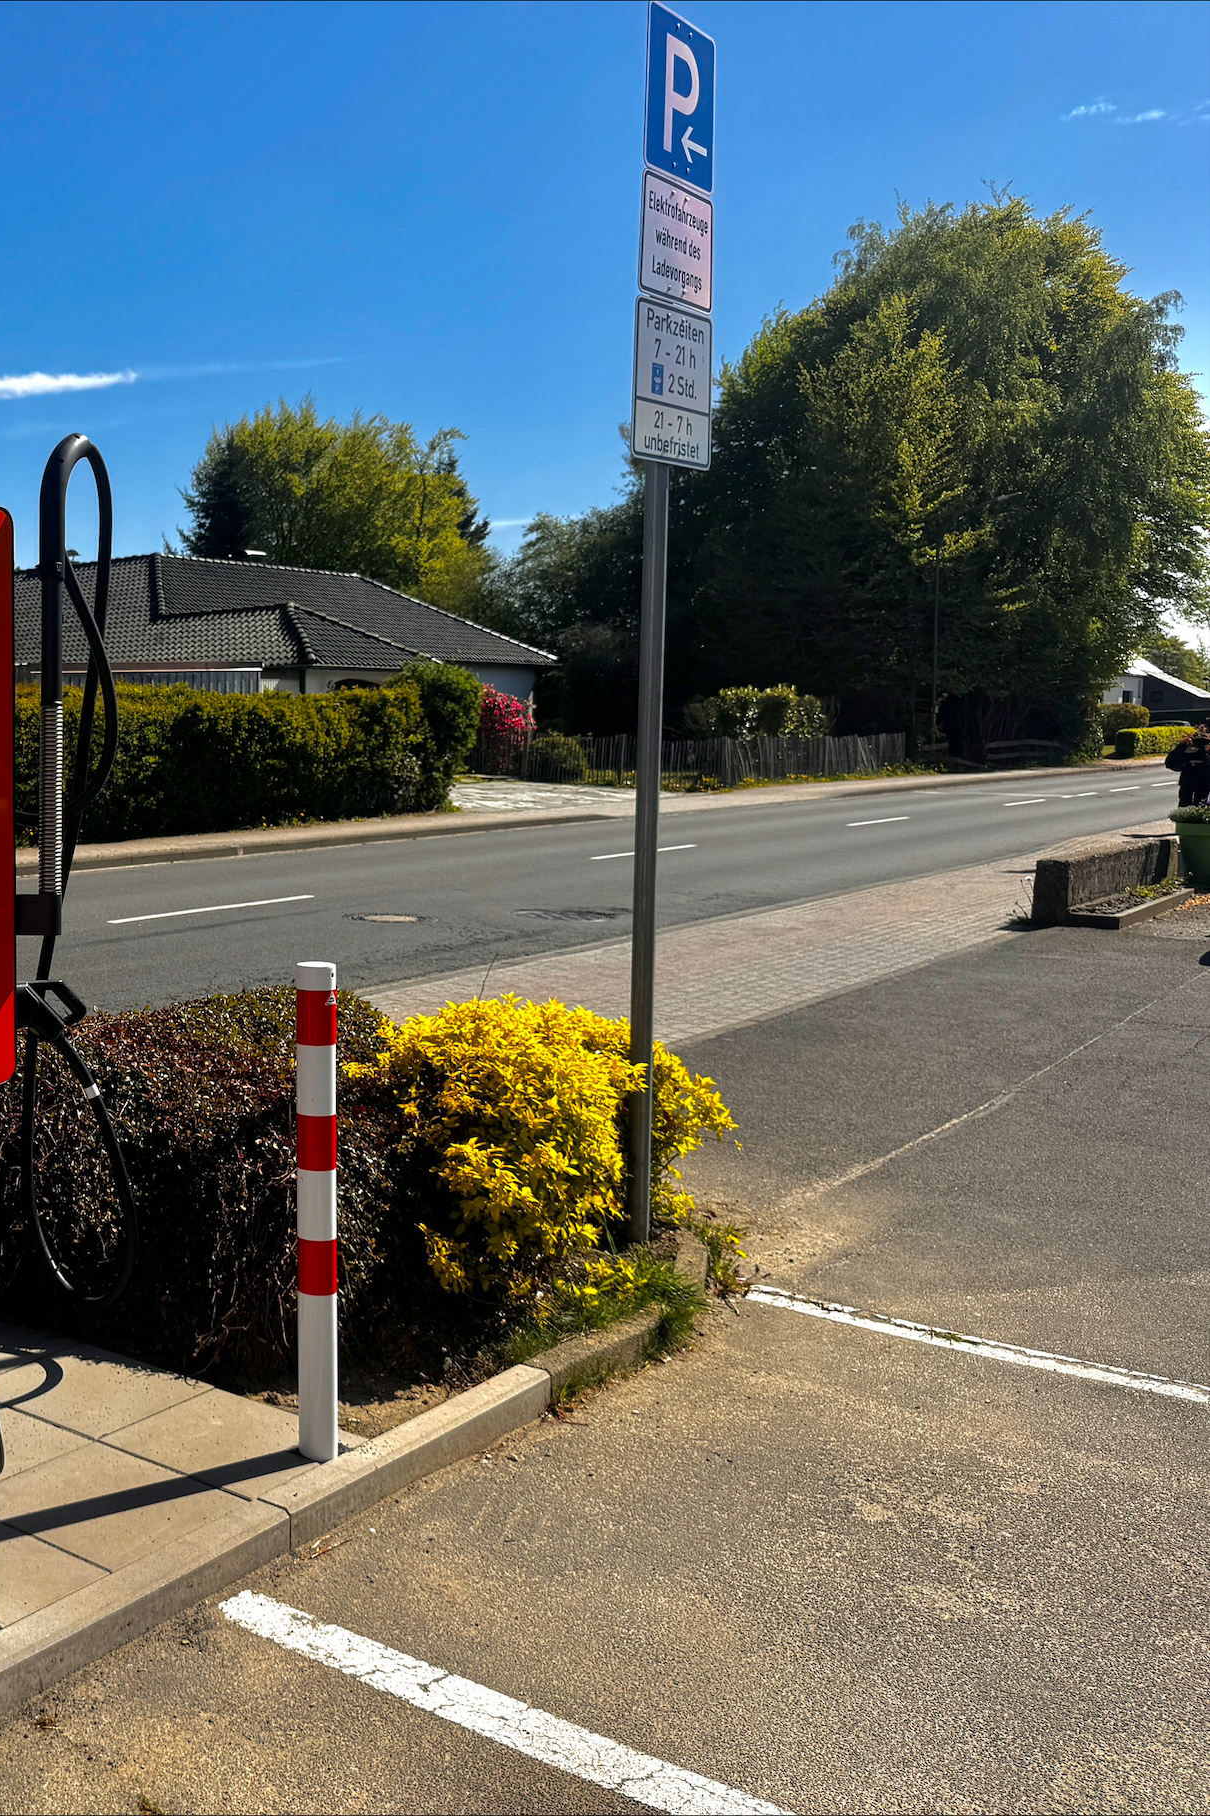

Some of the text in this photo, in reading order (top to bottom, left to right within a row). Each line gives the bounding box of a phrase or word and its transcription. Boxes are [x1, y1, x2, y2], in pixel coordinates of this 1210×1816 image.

[663, 33, 700, 153] P
[648, 190, 709, 237] Elektrofahrzeuge
[655, 226, 701, 261] während des
[651, 254, 703, 294] Ladevorgangs
[646, 307, 705, 345] Parkzeiten
[654, 338, 662, 359] 7
[675, 344, 685, 366] 21
[689, 348, 696, 369] h
[668, 373, 697, 400] 2 Std.
[654, 410, 664, 430] 21
[677, 415, 683, 433] 7
[686, 417, 693, 436] h
[644, 433, 700, 460] unbefristet
